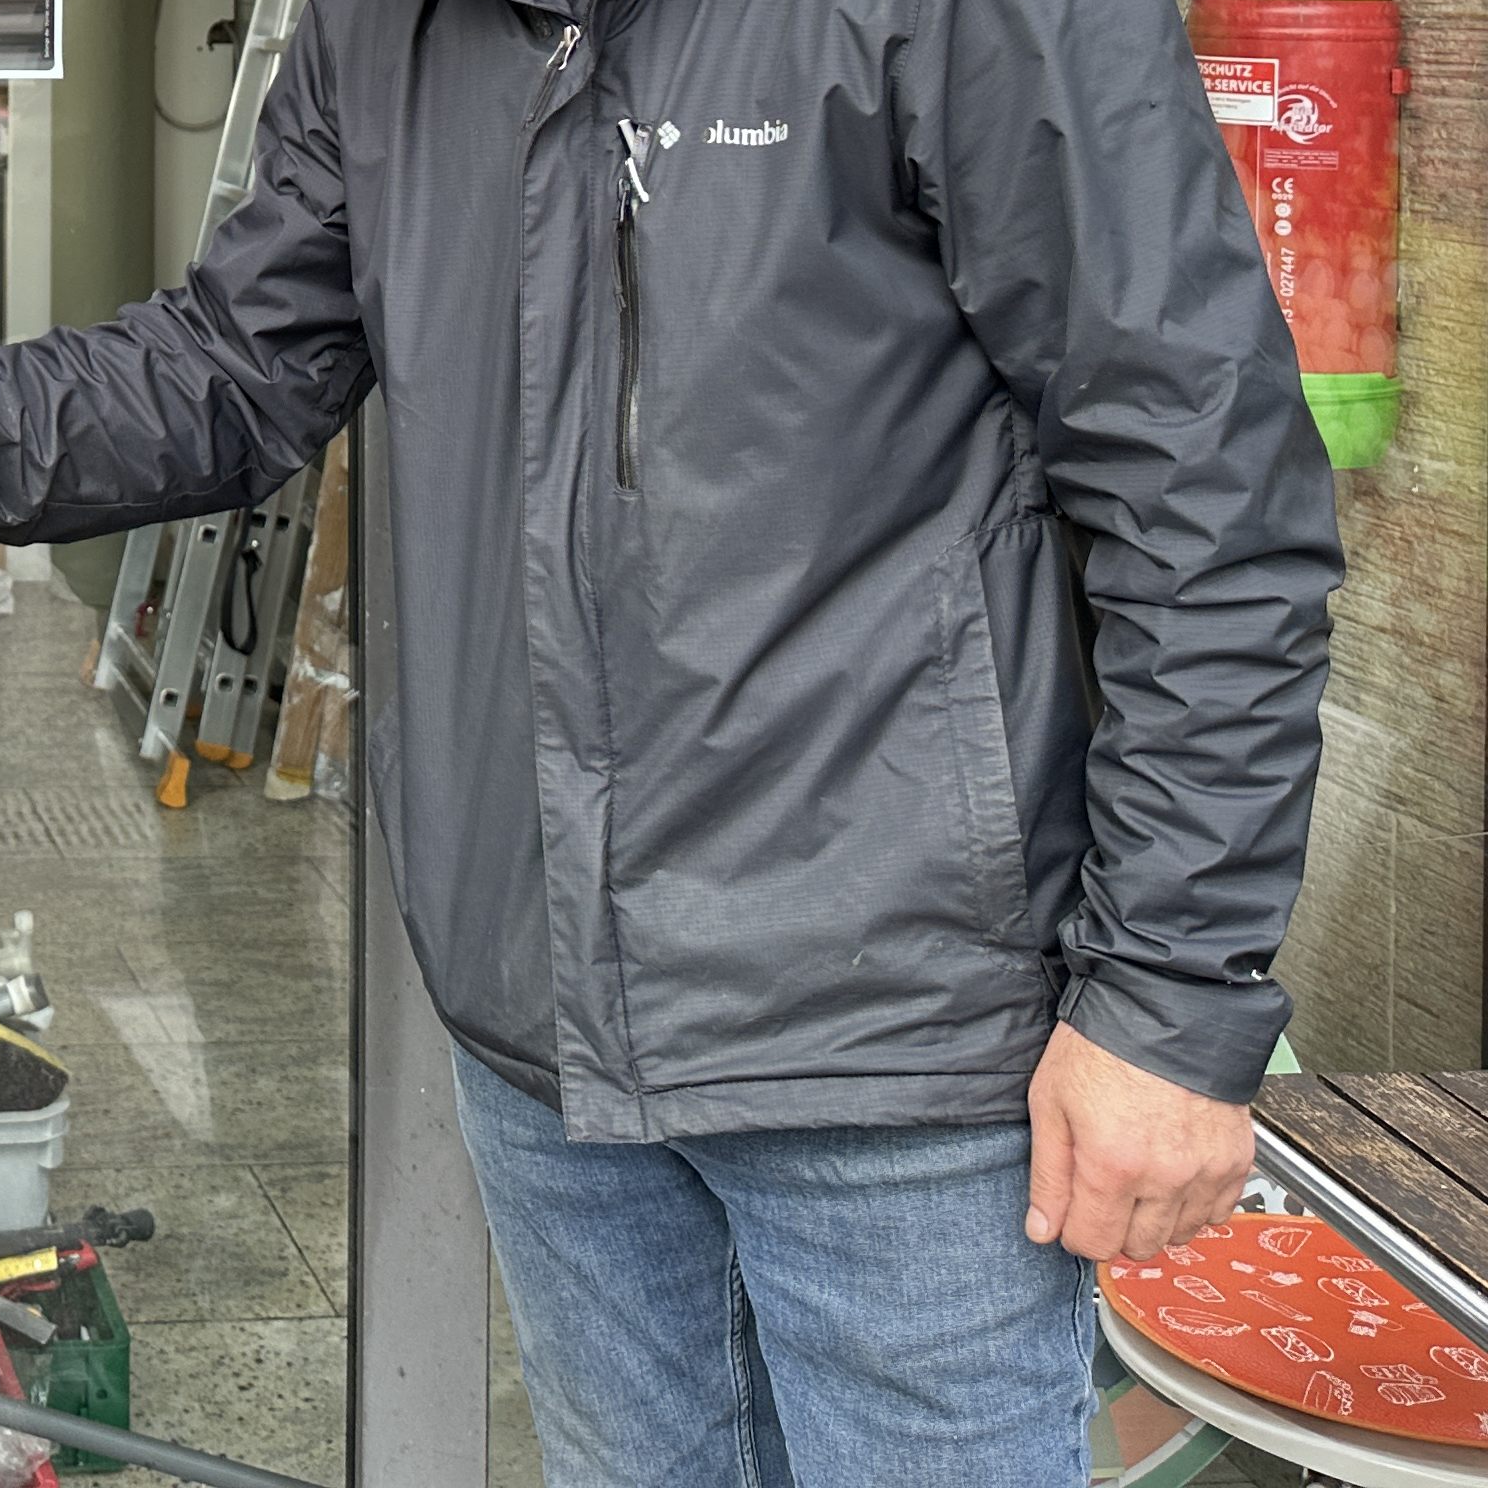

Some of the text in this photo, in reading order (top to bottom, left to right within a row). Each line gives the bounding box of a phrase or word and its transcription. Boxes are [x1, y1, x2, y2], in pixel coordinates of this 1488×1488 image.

[703, 119, 789, 146] olumbia
[1271, 177, 1294, 193] CE
[1279, 247, 1295, 297] 027447
